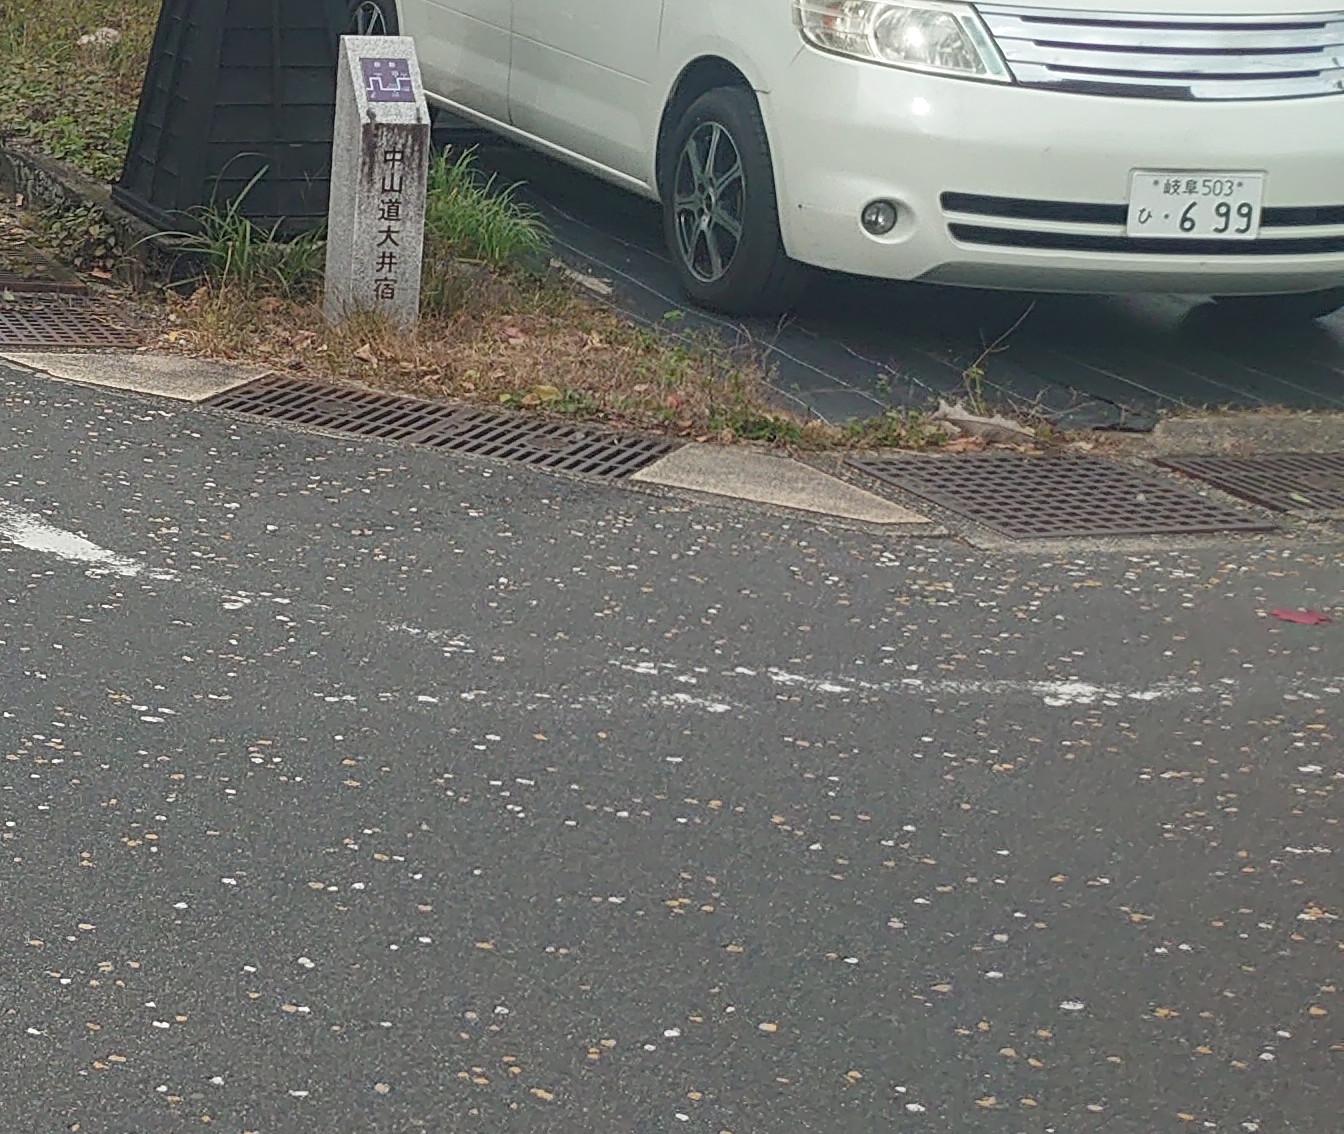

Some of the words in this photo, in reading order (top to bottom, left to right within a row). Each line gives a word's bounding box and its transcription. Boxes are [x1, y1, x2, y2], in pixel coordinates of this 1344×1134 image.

[374, 146, 405, 301] 中山道大井宿
